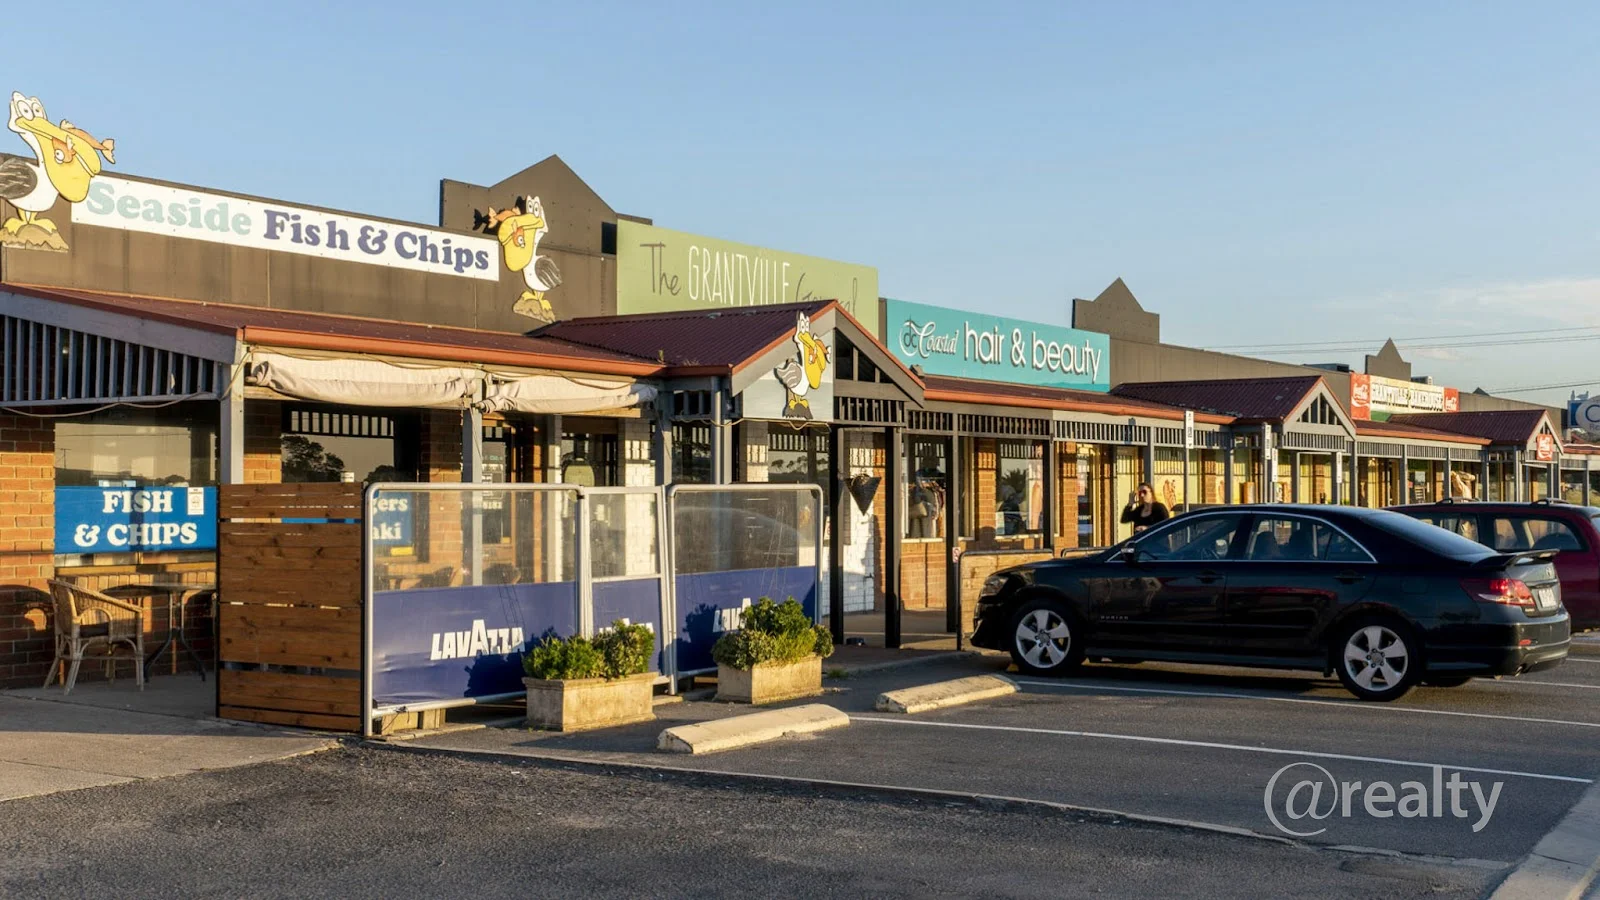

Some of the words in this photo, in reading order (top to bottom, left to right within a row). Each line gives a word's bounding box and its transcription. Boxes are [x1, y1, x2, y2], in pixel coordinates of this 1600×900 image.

[86, 181, 252, 235] Seaside
[263, 209, 350, 250] Fish
[357, 225, 388, 255] &
[394, 231, 489, 273] Chips
[640, 242, 682, 296] The
[688, 245, 791, 307] GRANTVILLE
[964, 320, 1006, 365] hair
[1010, 328, 1027, 368] &
[1032, 331, 1101, 384] beauty
[102, 490, 173, 513] FISH
[74, 524, 101, 547] &
[107, 522, 198, 547] CHIPS
[430, 619, 526, 661] LAVAZZA
